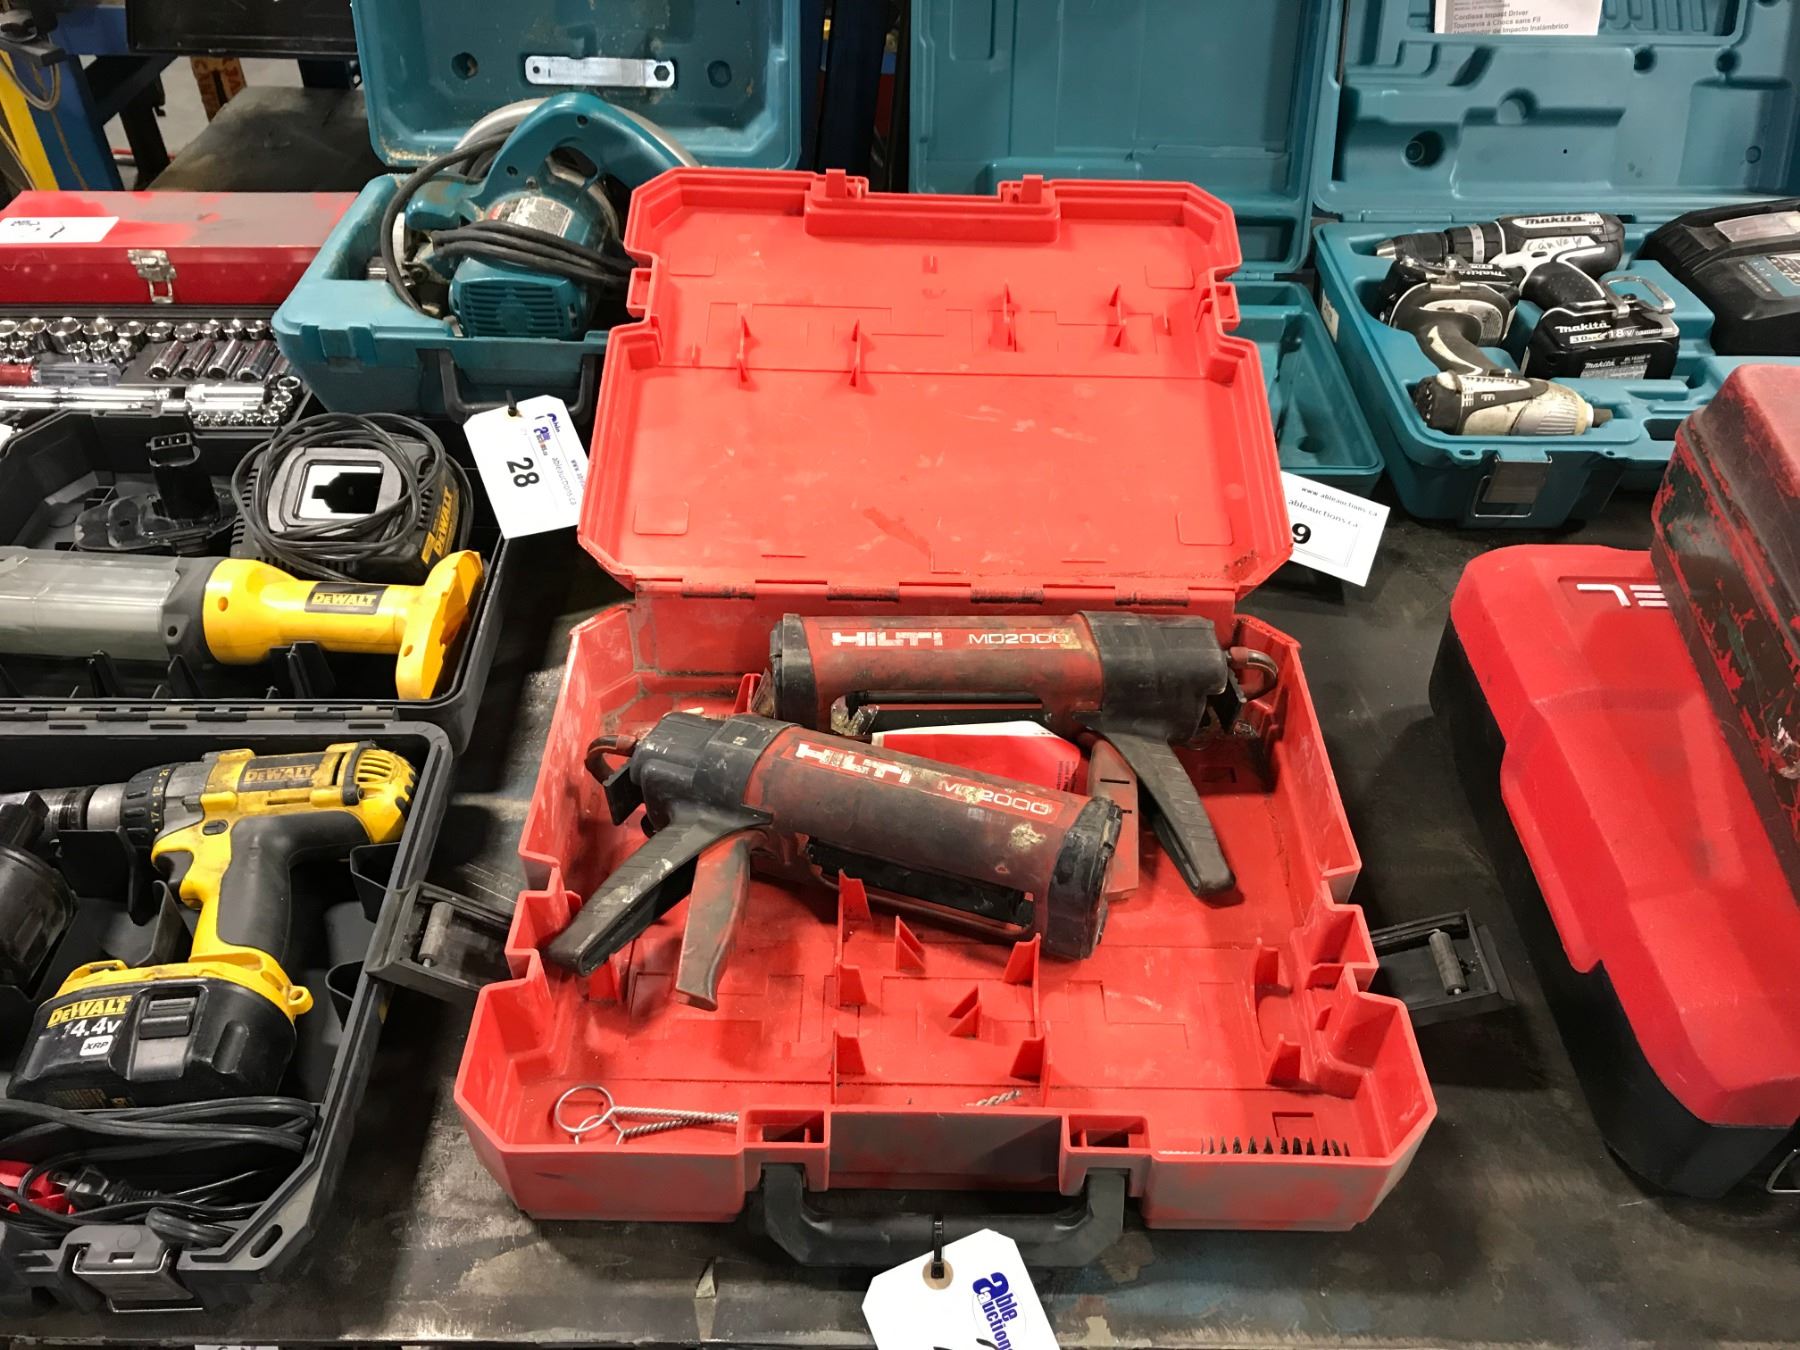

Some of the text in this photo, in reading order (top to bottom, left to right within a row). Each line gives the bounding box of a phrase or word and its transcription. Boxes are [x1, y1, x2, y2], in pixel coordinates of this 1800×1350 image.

[1508, 9, 1529, 17] Driver
[1532, 15, 1541, 23] Fil
[1525, 215, 1585, 225] makita
[1554, 319, 1612, 334] makita
[506, 456, 540, 488] 28
[1291, 522, 1312, 545] 9
[830, 631, 1070, 647] HILTI MD2000
[794, 742, 913, 785] HILTI
[83, 1041, 110, 1051] XRP
